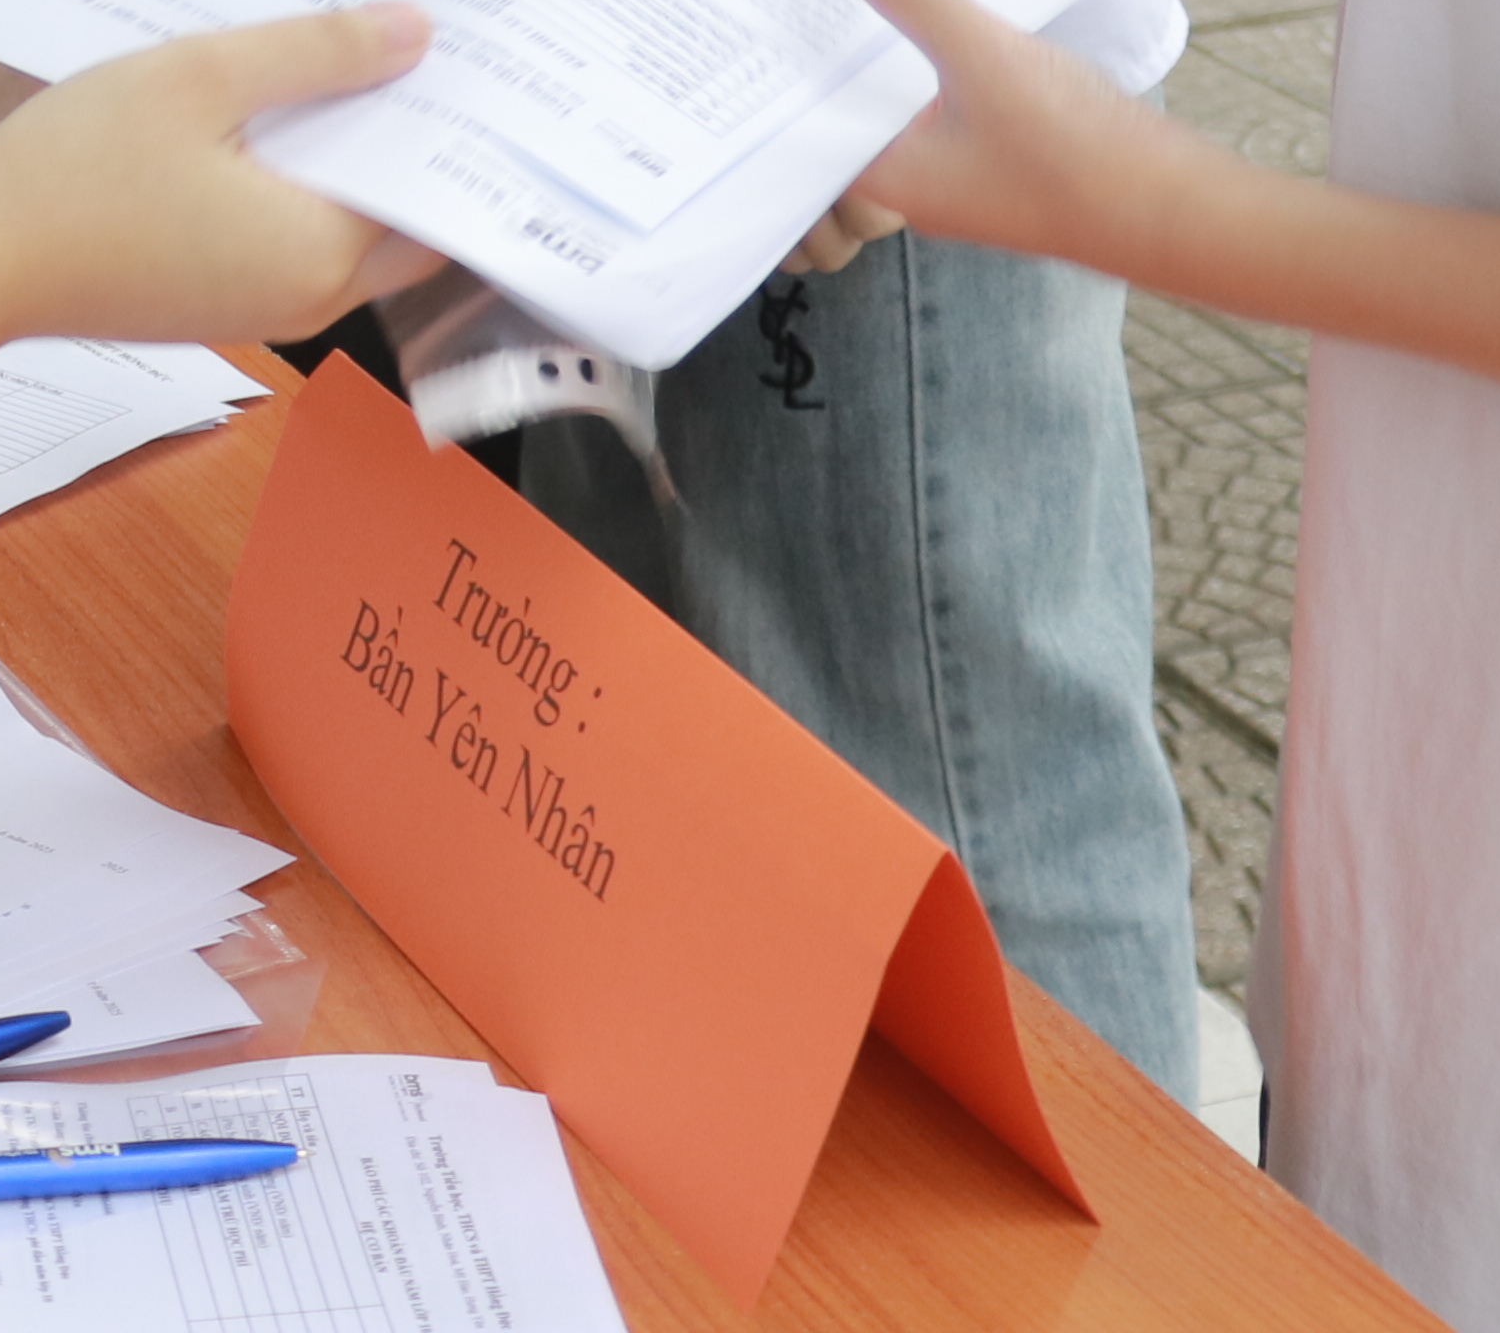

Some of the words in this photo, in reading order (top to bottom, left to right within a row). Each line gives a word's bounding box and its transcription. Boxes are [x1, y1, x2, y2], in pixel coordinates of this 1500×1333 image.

[523, 218, 603, 274] bms
[433, 537, 578, 727] Trường
[340, 597, 415, 717] Bần
[426, 667, 498, 796] Yên
[501, 744, 615, 904] Nhân
[403, 1073, 423, 1097] bms
[473, 1256, 495, 1283] THPT
